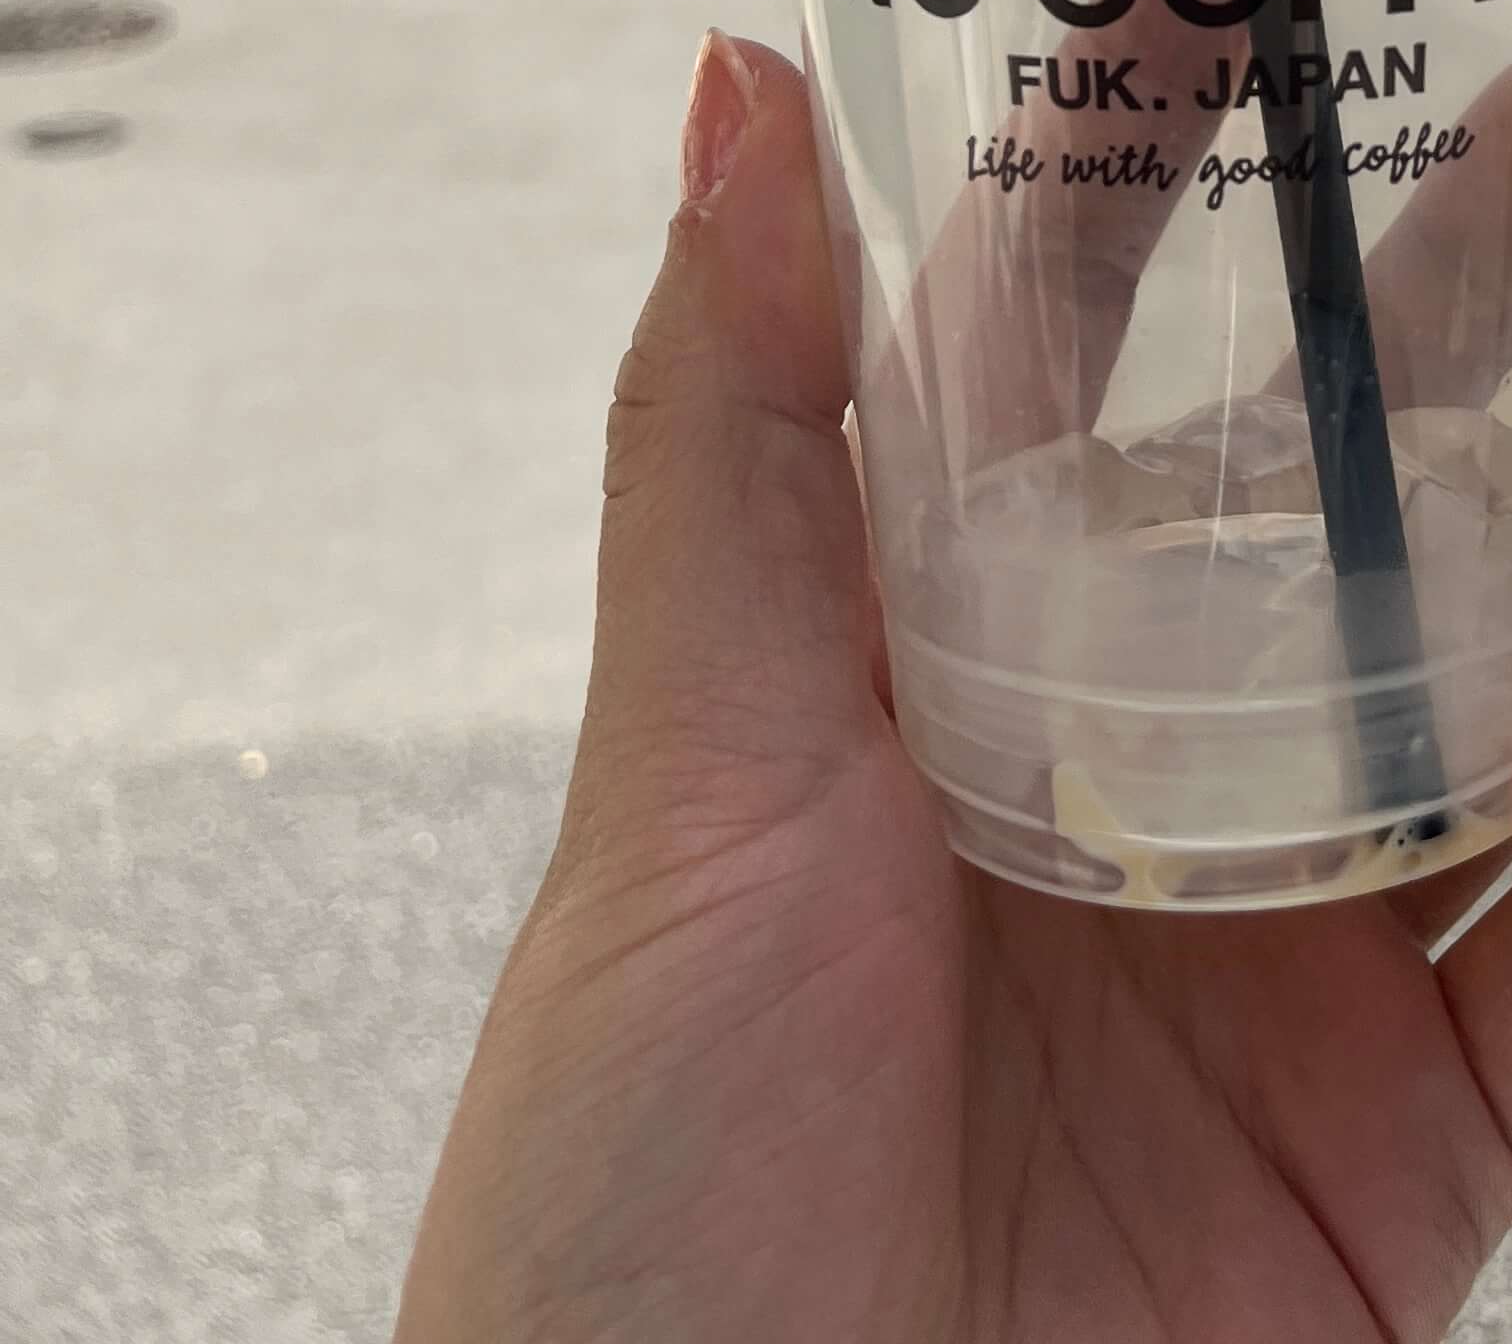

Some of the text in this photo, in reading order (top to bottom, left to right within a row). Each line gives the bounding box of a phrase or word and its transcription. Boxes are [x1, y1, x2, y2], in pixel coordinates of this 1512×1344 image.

[1006, 42, 1427, 111] FUK. JAPAN
[966, 122, 1476, 210] Life with good coffee
